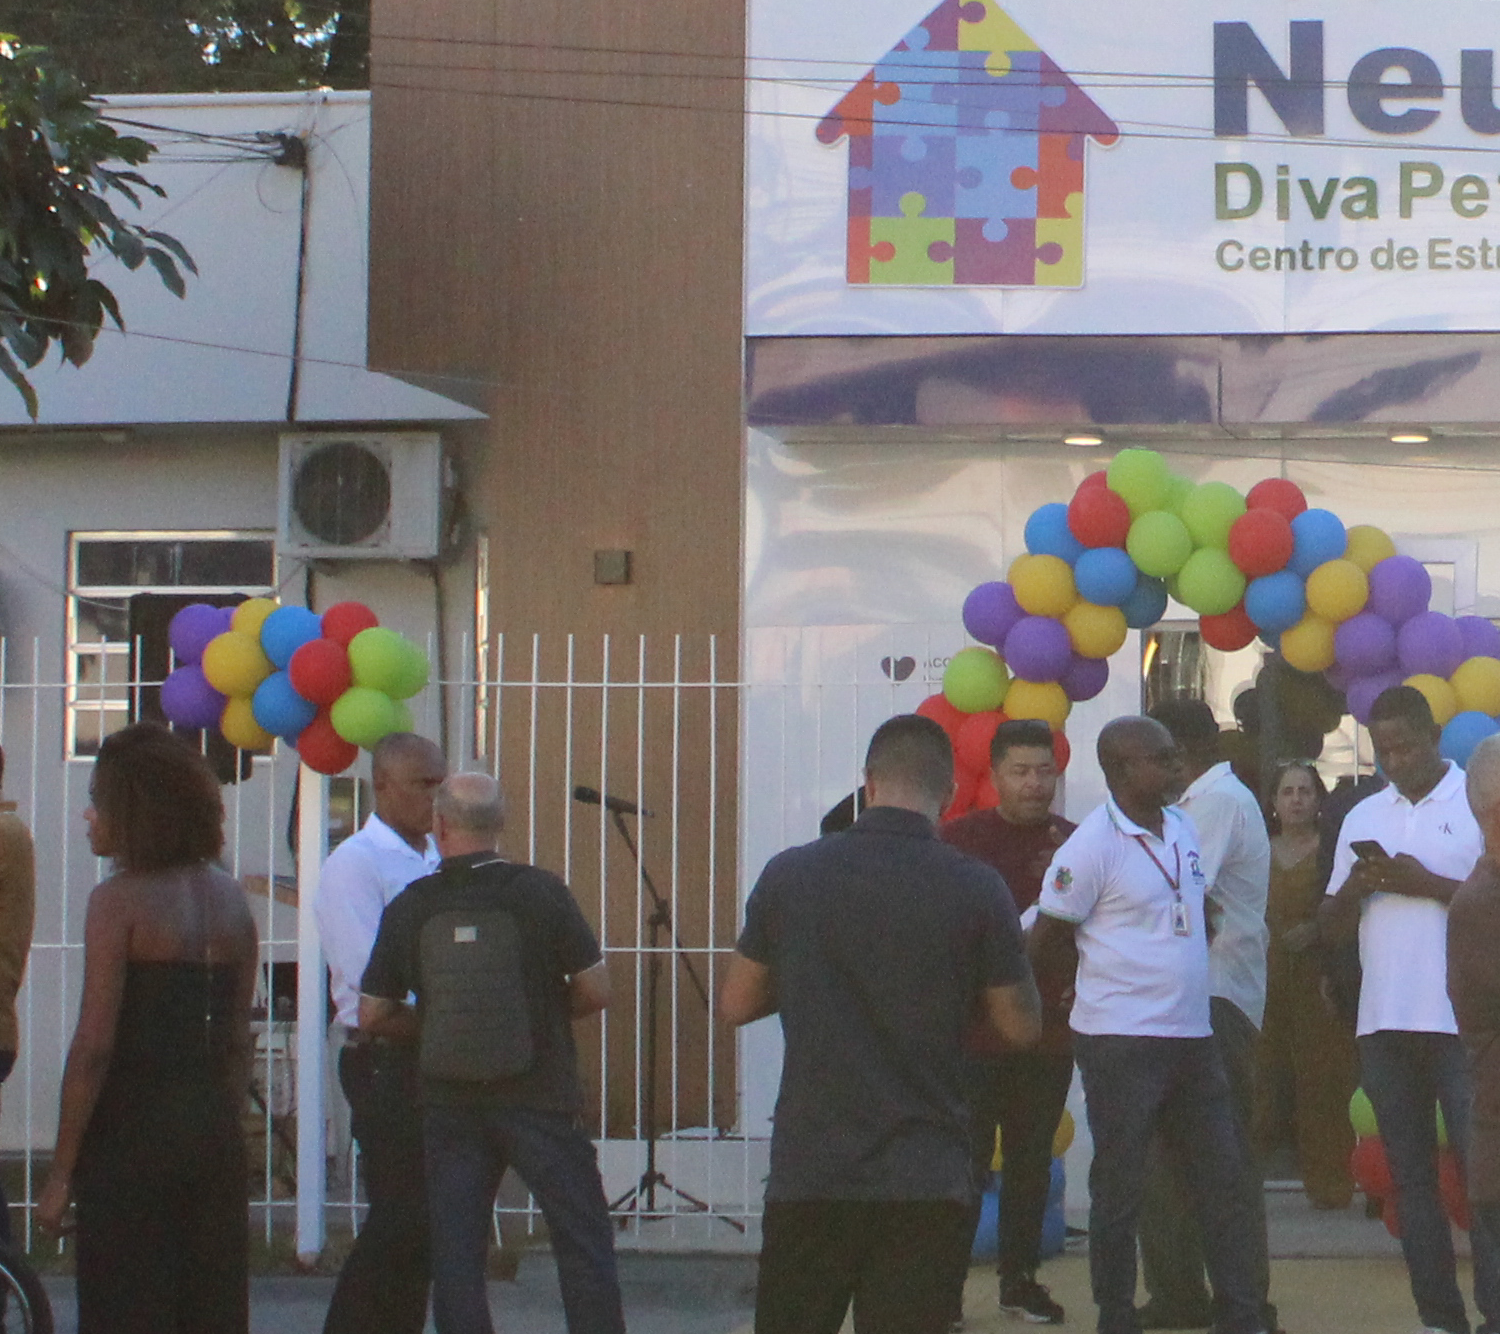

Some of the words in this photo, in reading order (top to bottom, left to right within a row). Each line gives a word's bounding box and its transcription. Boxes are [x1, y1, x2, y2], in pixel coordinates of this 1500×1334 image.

[1214, 161, 1380, 220] Diva
[1215, 239, 1360, 271] Centro
[1370, 240, 1420, 269] de
